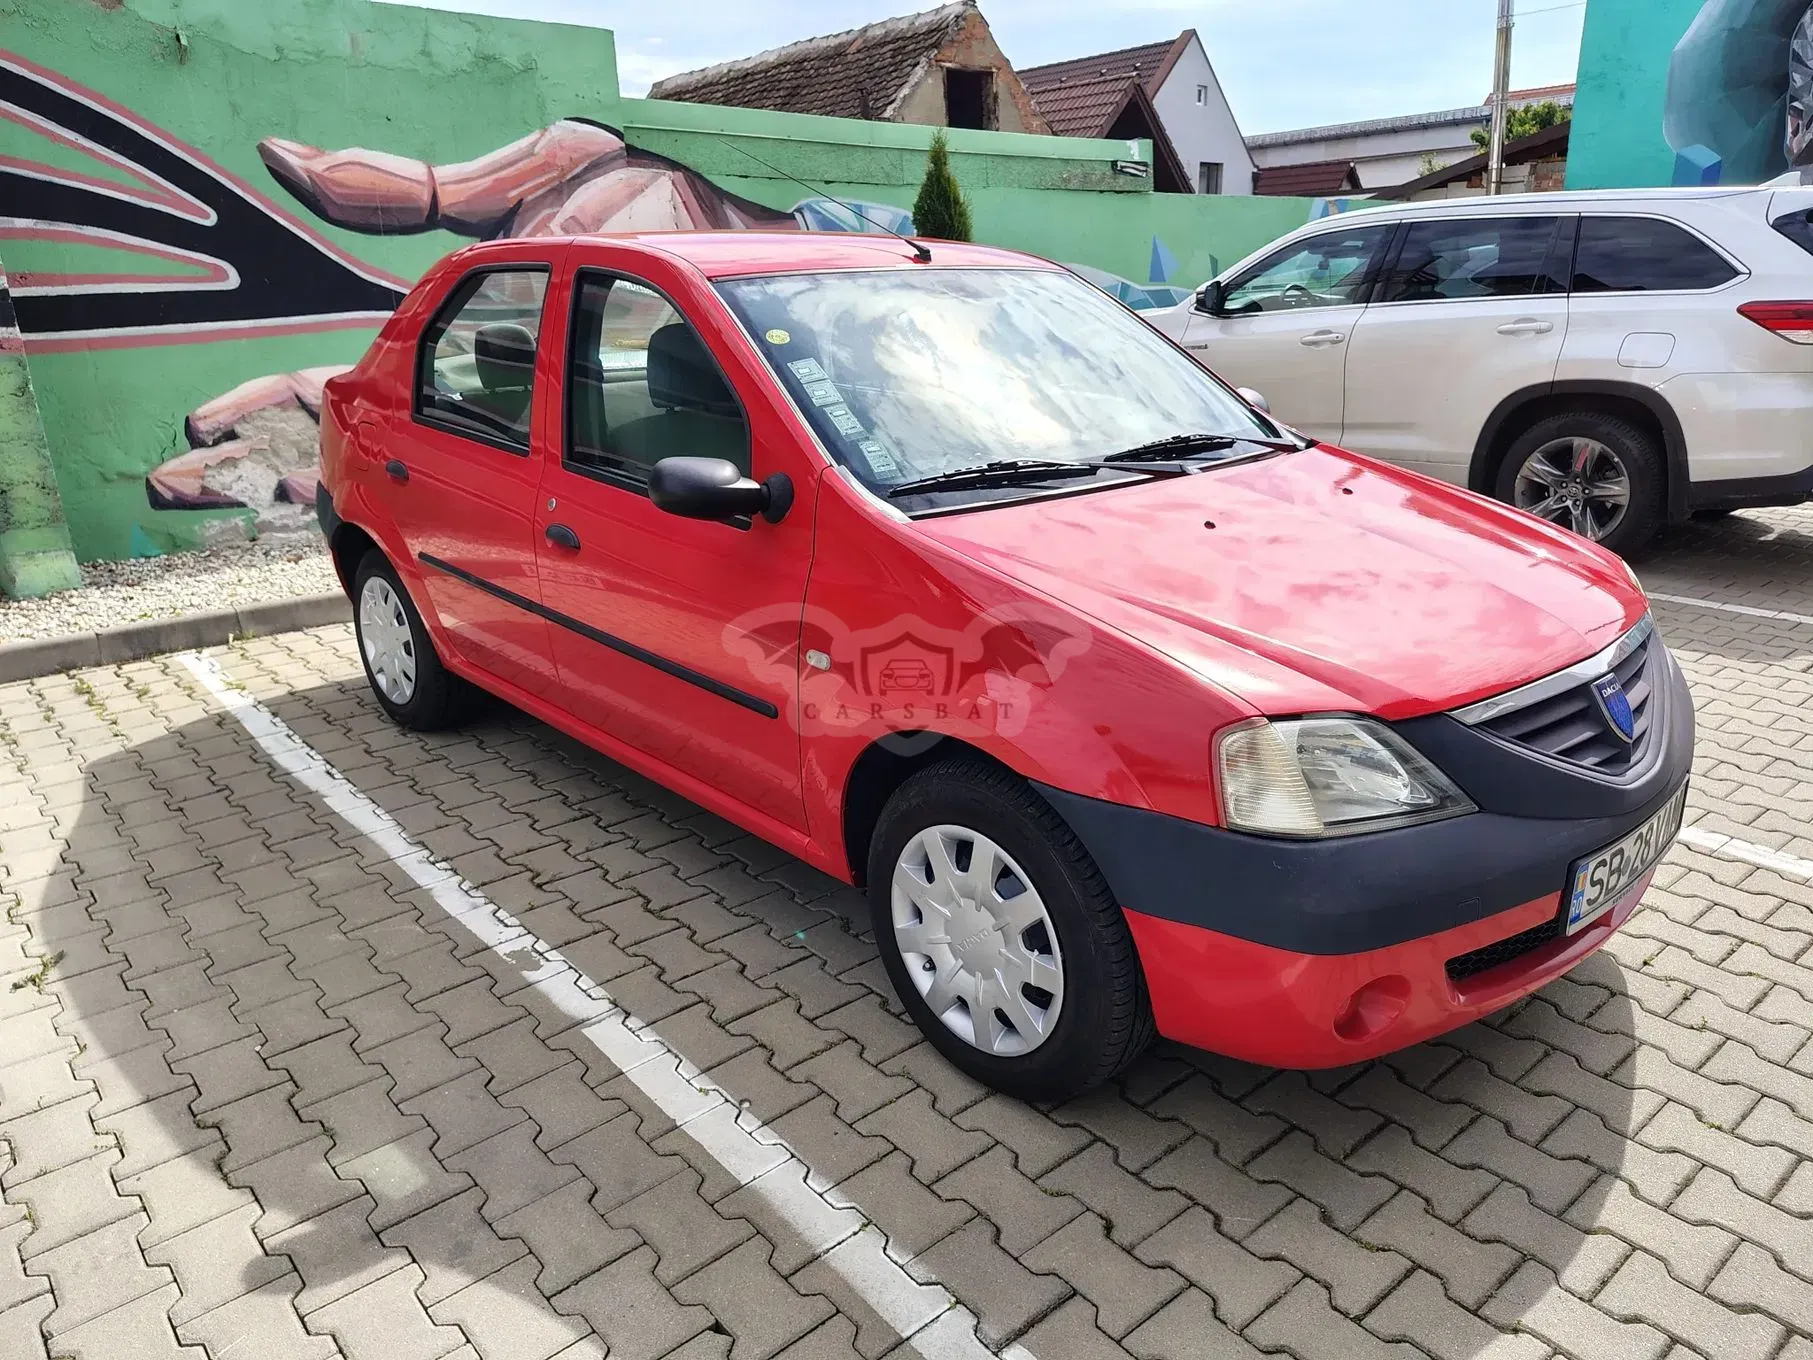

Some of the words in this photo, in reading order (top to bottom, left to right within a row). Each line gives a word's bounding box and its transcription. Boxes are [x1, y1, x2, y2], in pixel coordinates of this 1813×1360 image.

[1586, 847, 1625, 907] SB
[1628, 821, 1655, 880] 28
[1571, 896, 1583, 917] RO
